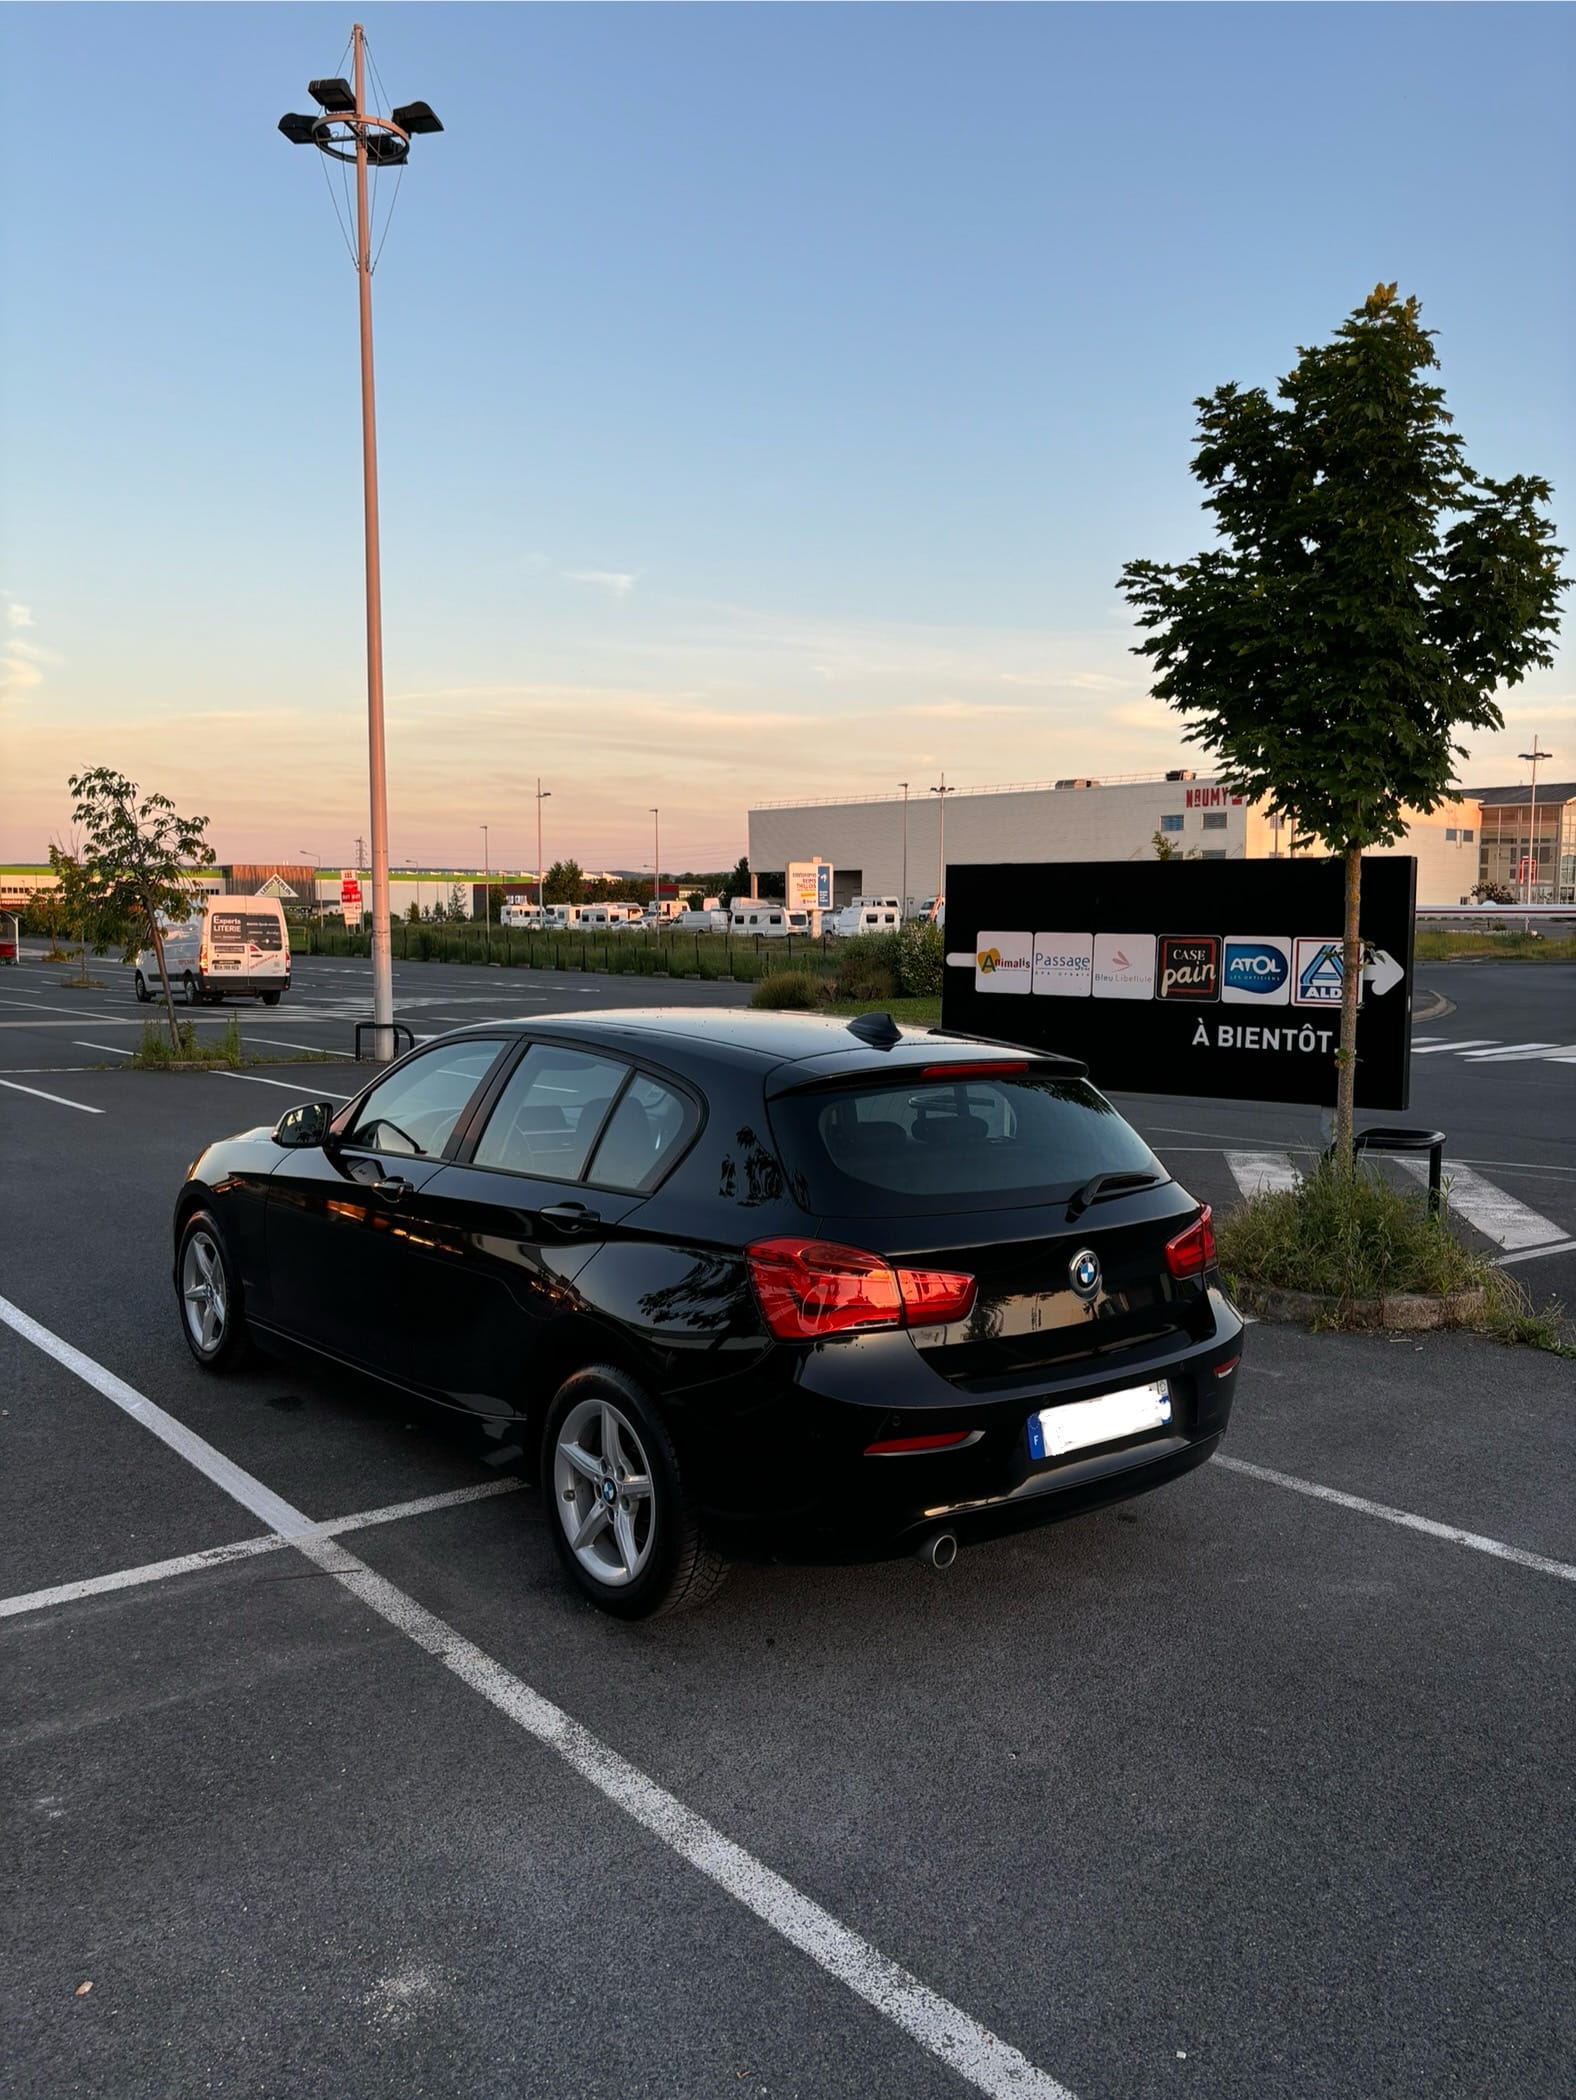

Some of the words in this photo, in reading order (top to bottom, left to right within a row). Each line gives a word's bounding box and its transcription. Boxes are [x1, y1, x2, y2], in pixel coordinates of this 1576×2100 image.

[274, 876, 292, 895] MERLIN
[213, 915, 241, 925] Experts
[213, 925, 241, 933] LITERIE
[1035, 952, 1090, 970] Passage
[1173, 949, 1206, 961] CASE
[981, 954, 1031, 973] Animalis
[1230, 955, 1281, 975] ATOL
[1095, 973, 1114, 982] Bleu
[1161, 960, 1216, 998] pain
[1305, 986, 1343, 999] ALD
[1192, 1018, 1210, 1047] À
[1033, 1435, 1039, 1446] F
